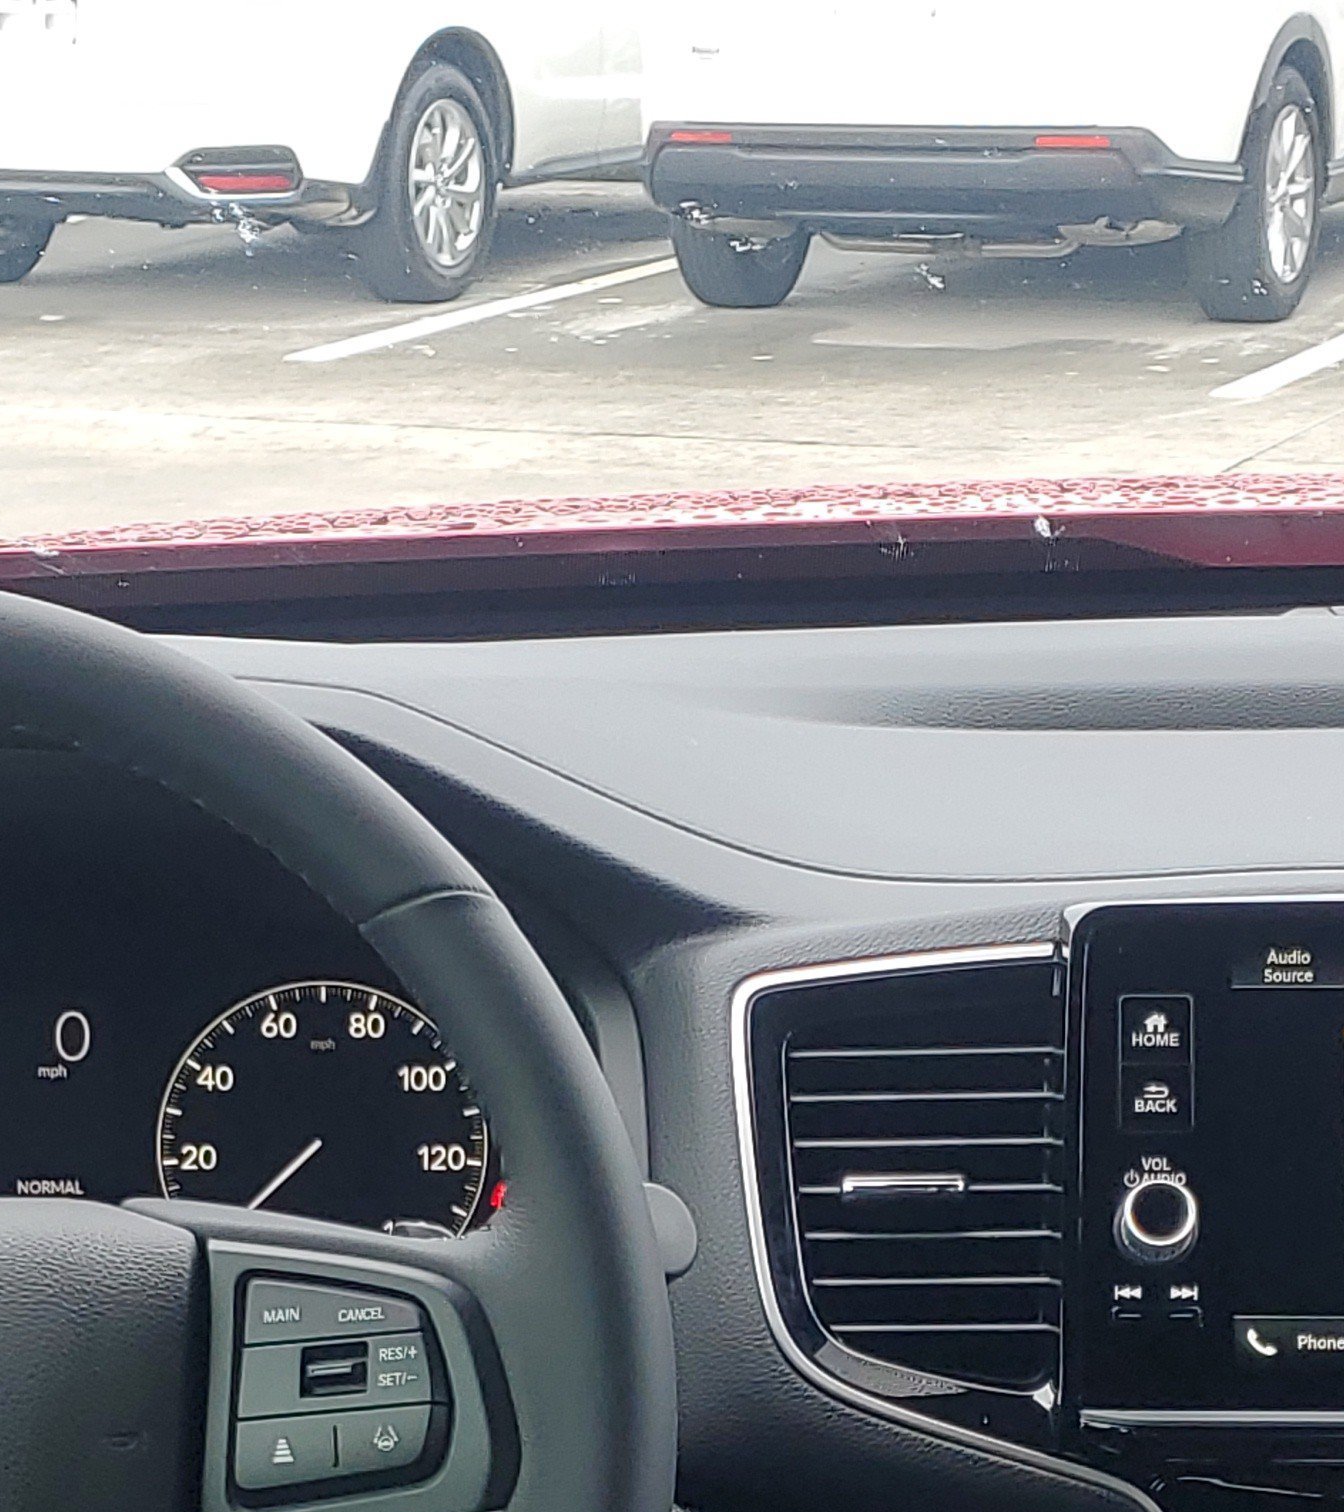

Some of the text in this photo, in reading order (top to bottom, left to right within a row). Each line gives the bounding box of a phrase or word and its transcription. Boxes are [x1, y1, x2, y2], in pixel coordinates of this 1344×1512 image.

[1266, 948, 1311, 966] Audio
[1263, 967, 1314, 983] Source
[260, 1012, 297, 1038] 60
[348, 1012, 386, 1038] 80
[55, 1010, 90, 1062] 0
[310, 1037, 336, 1051] mph
[1131, 1032, 1180, 1047] HOME
[37, 1063, 68, 1080] mph
[196, 1066, 234, 1091] 40
[397, 1066, 446, 1091] 100
[1134, 1099, 1177, 1113] BACK
[180, 1145, 217, 1171] 20
[417, 1145, 466, 1172] 120
[1141, 1156, 1172, 1171] VOL
[16, 1178, 84, 1195] NORMAL
[263, 1307, 301, 1324] MAIN
[337, 1307, 385, 1323] CANCEL
[378, 1345, 418, 1362] RES/+
